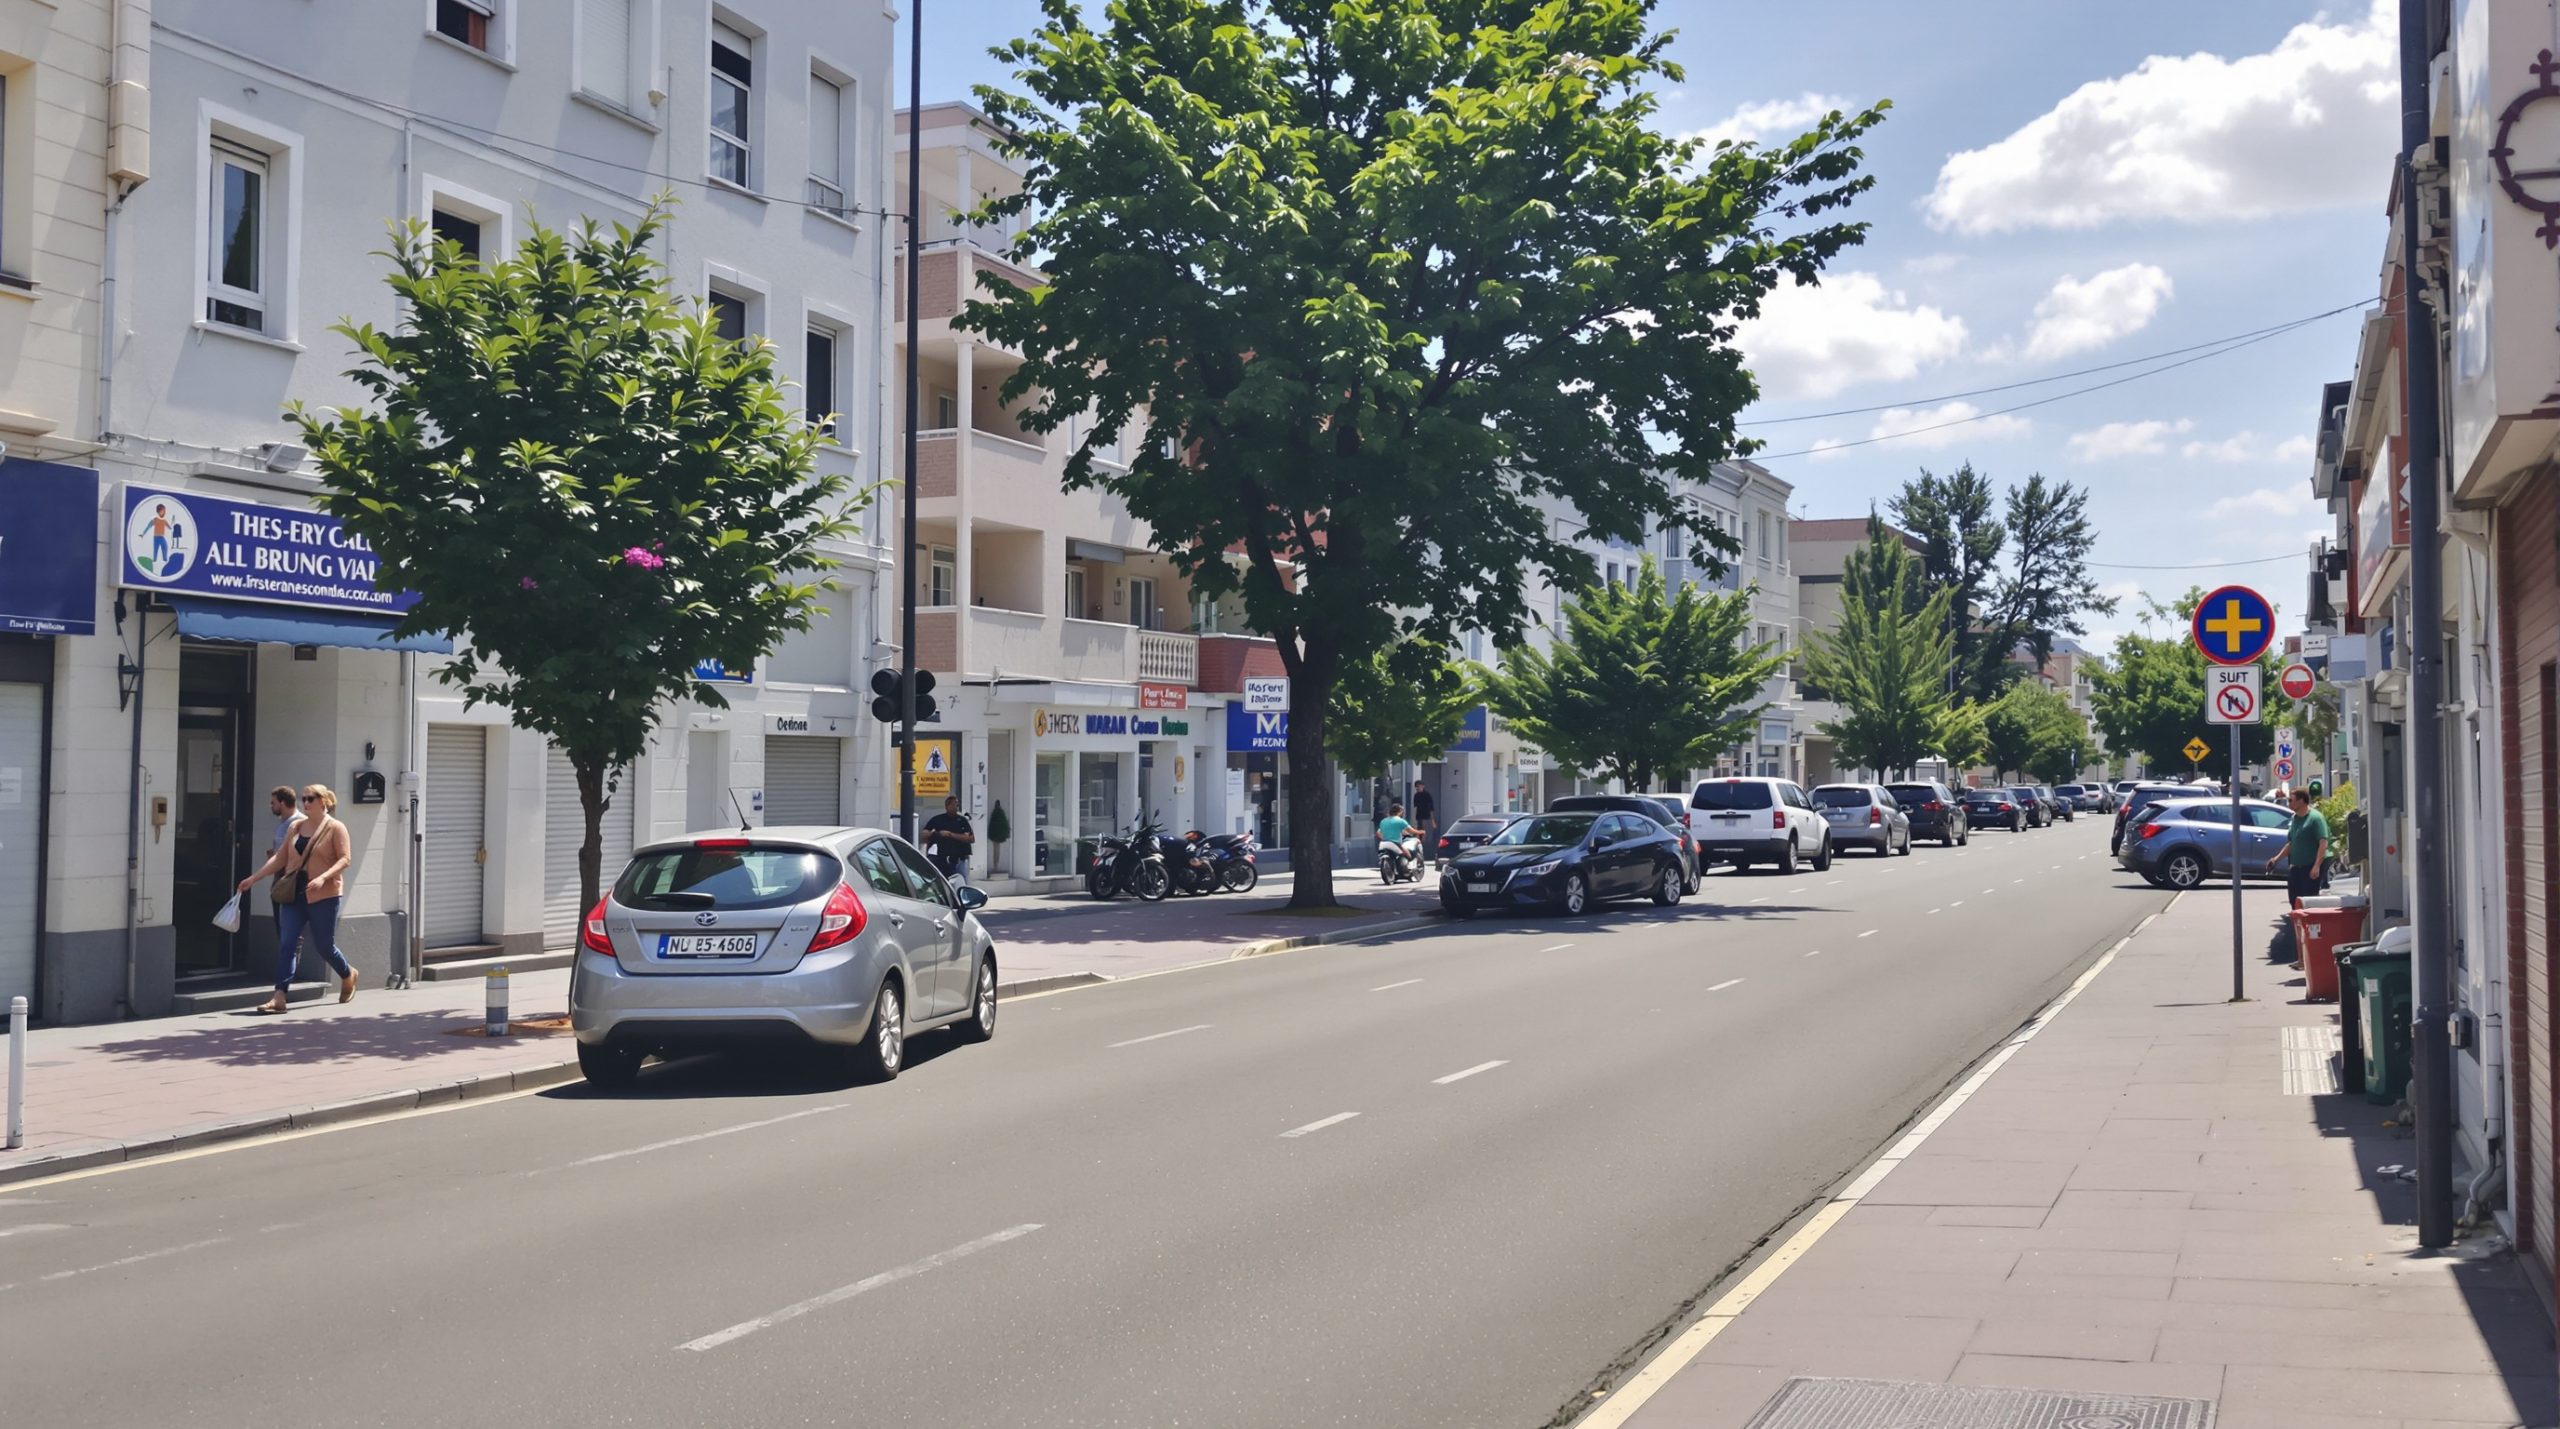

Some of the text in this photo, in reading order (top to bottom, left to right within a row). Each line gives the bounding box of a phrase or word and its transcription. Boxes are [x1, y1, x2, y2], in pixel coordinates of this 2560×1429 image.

[230, 511, 326, 546] THES-ERY
[205, 541, 248, 568] ALL
[254, 547, 333, 578] BRUNG
